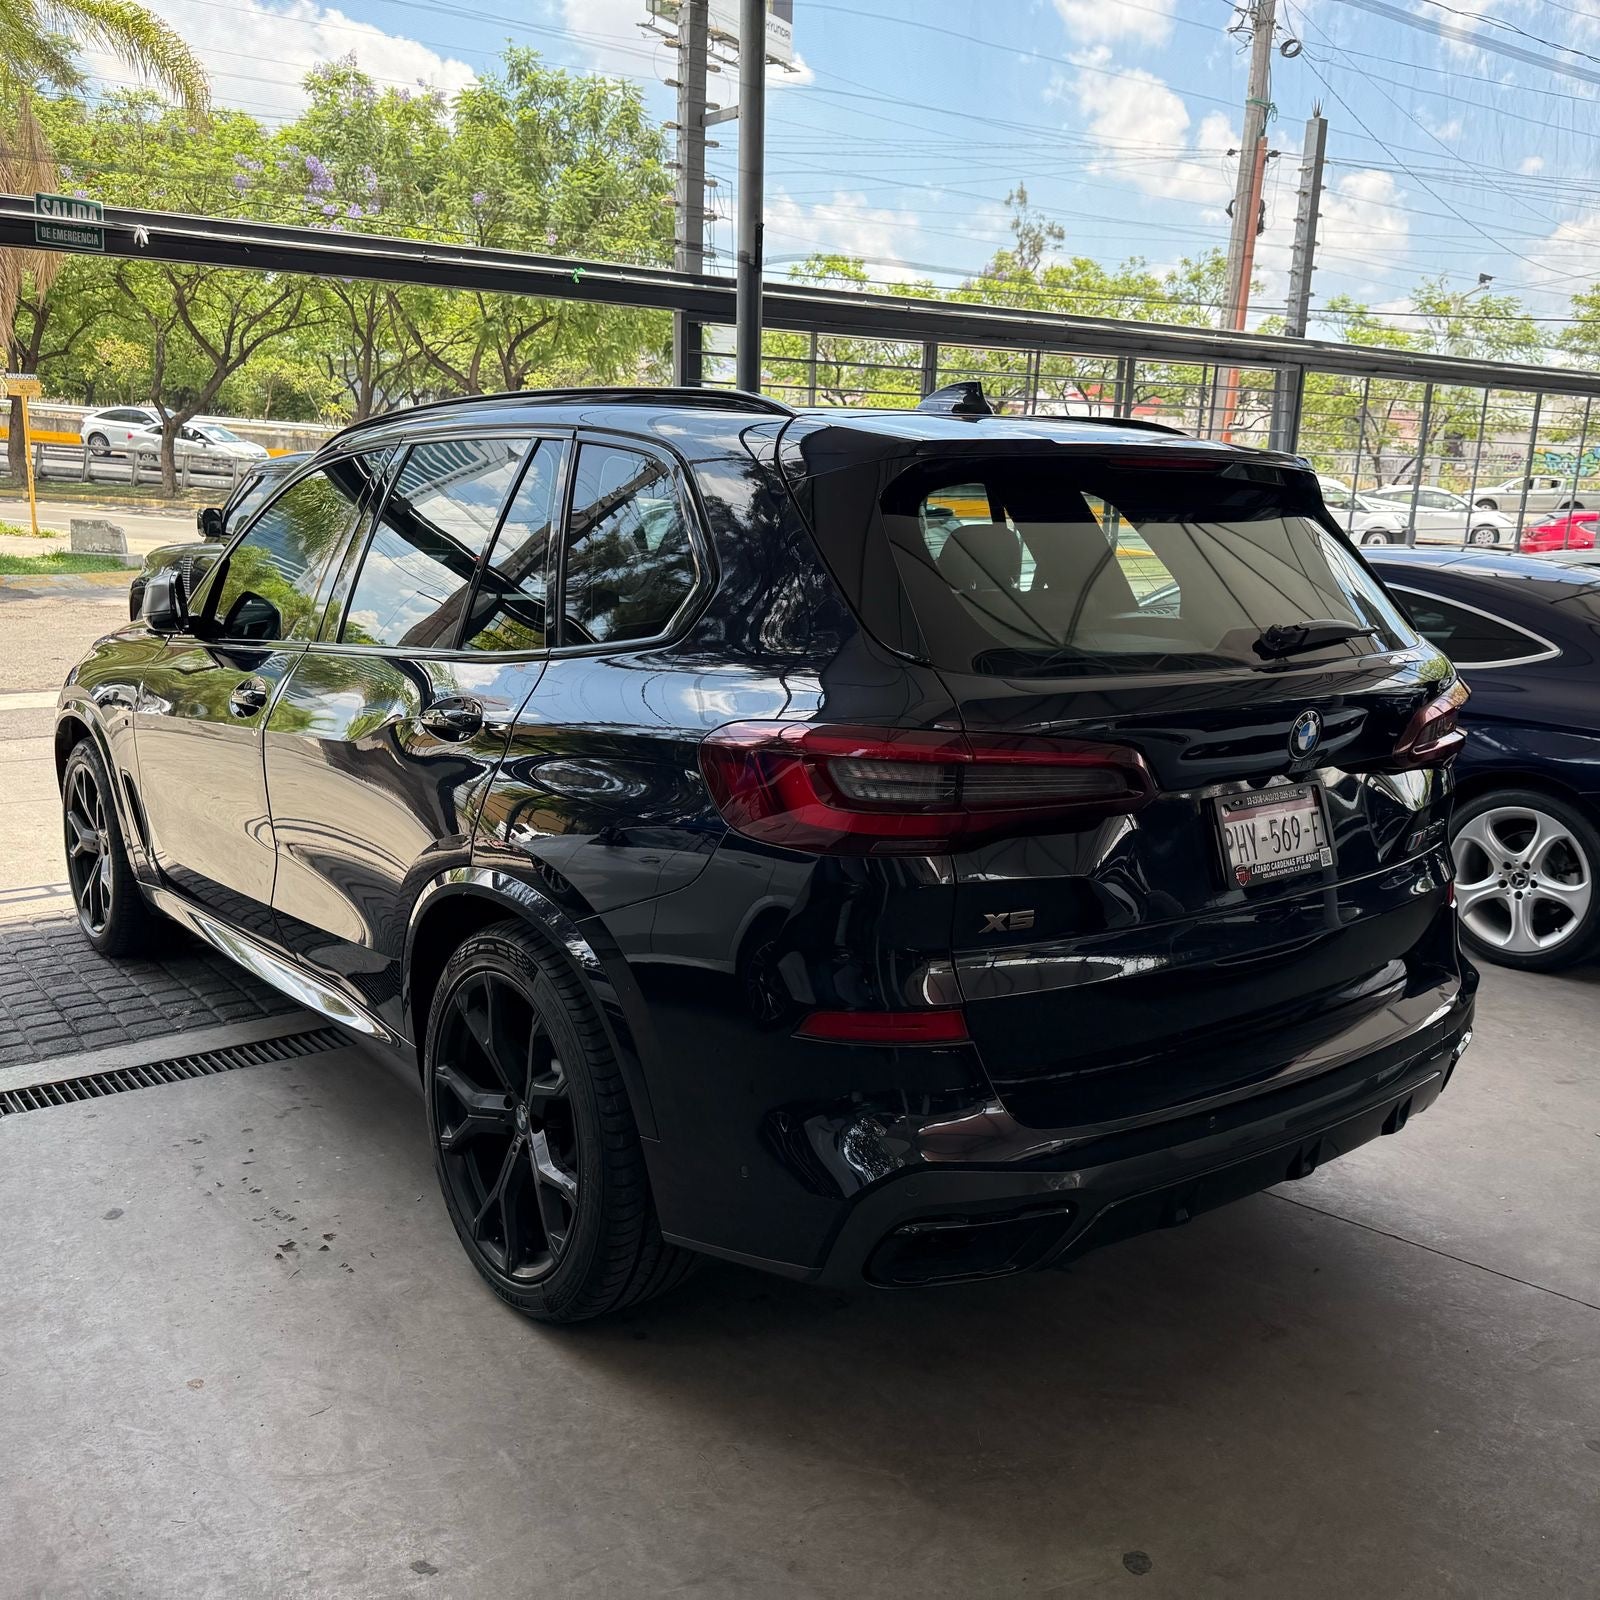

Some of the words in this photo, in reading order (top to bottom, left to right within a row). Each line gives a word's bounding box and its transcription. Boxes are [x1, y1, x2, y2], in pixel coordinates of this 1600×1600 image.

[40, 199, 99, 230] SALIDA
[41, 227, 51, 239] DE
[52, 228, 99, 245] EMERGENCIA
[978, 909, 1035, 933] X5
